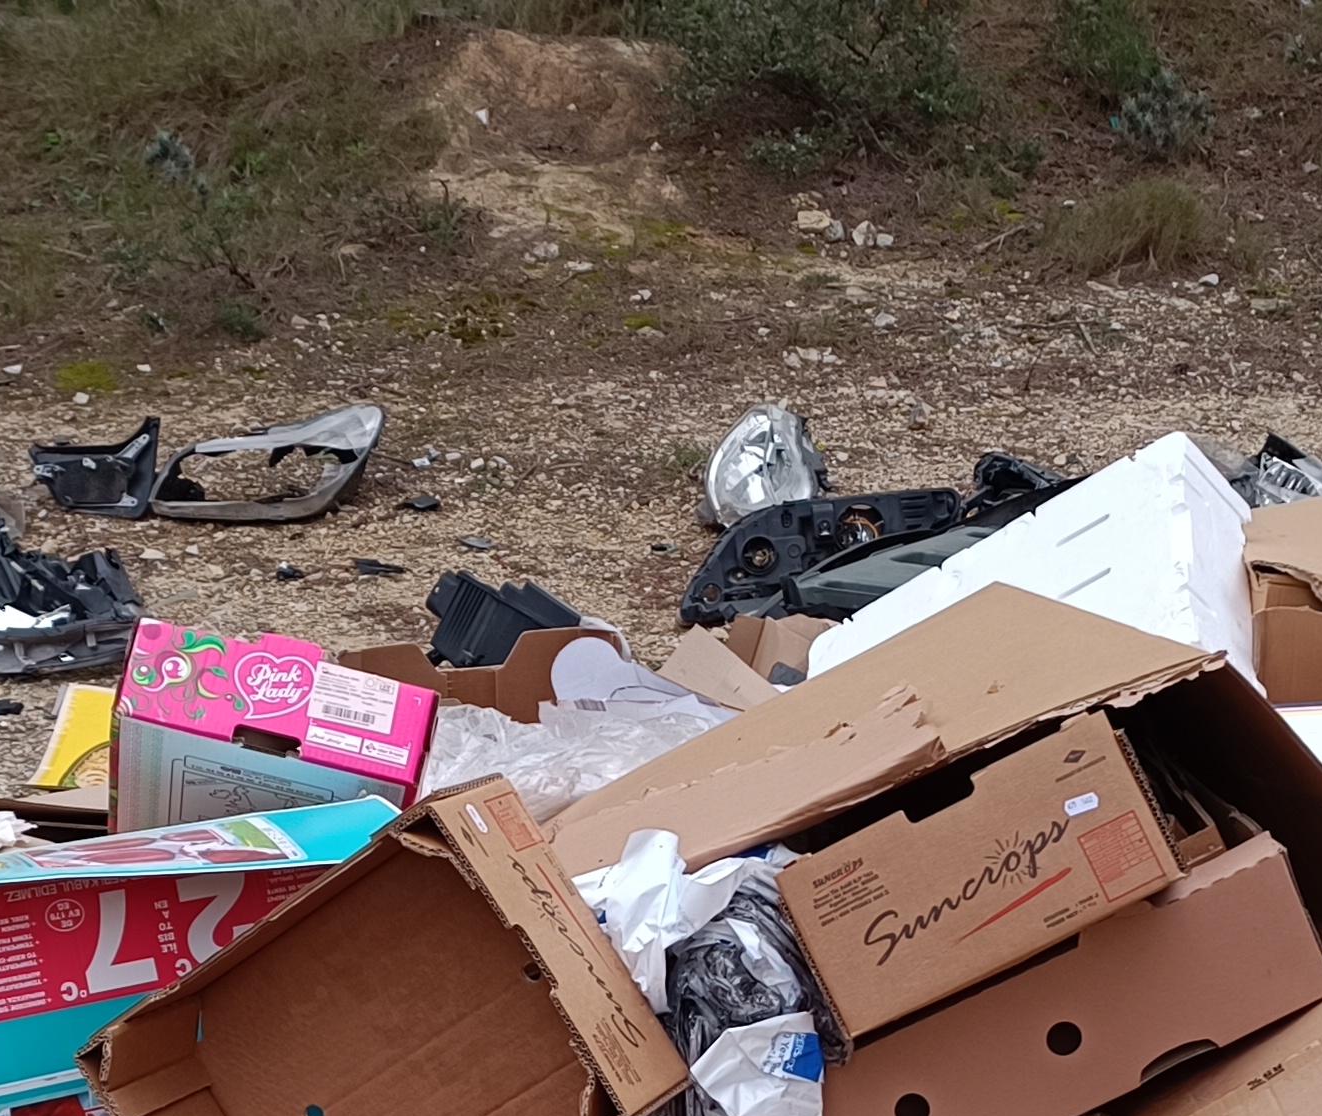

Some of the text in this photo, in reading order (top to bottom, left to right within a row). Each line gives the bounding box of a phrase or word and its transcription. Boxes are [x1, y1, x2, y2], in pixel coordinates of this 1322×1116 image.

[247, 663, 302, 687] Pink
[250, 681, 305, 704] Lady
[84, 888, 158, 993] 7
[864, 818, 1071, 966] Suncrops
[509, 853, 648, 1050] Suncrops
